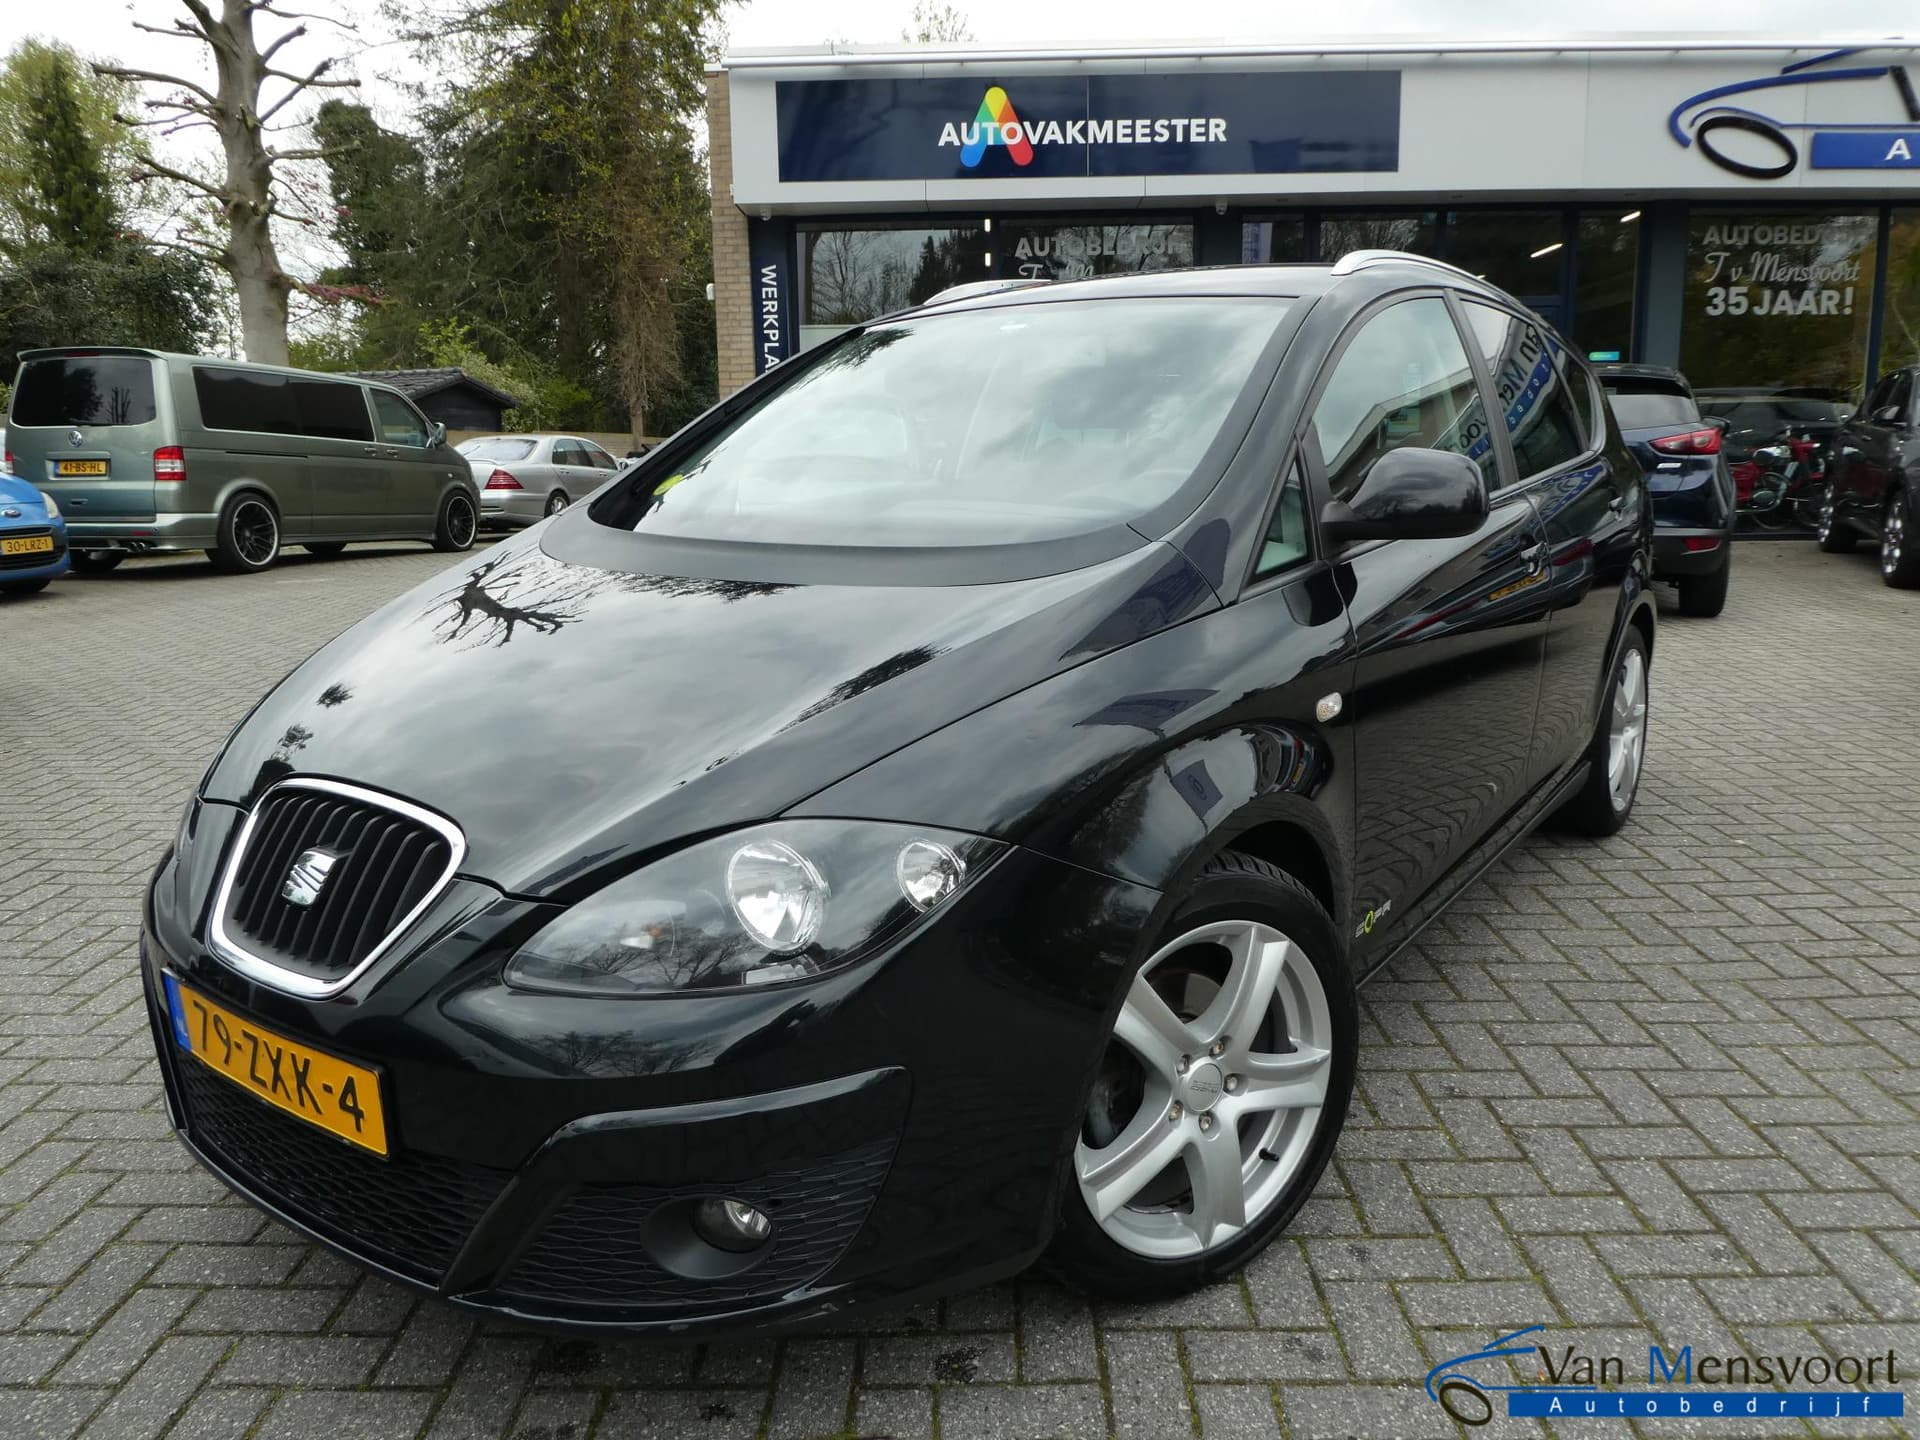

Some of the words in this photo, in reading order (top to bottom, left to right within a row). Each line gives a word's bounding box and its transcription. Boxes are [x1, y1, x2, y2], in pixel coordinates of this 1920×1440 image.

[938, 118, 1228, 147] AUTOVAKMEESTER
[1702, 225, 1854, 246] AUTOBED
[1750, 251, 1861, 282] Mensvoort
[1705, 286, 1749, 316] 35
[1752, 286, 1855, 316] JAAR!
[7, 538, 49, 553] 30-LRZ-1
[192, 999, 365, 1134] 79-ZXK-4
